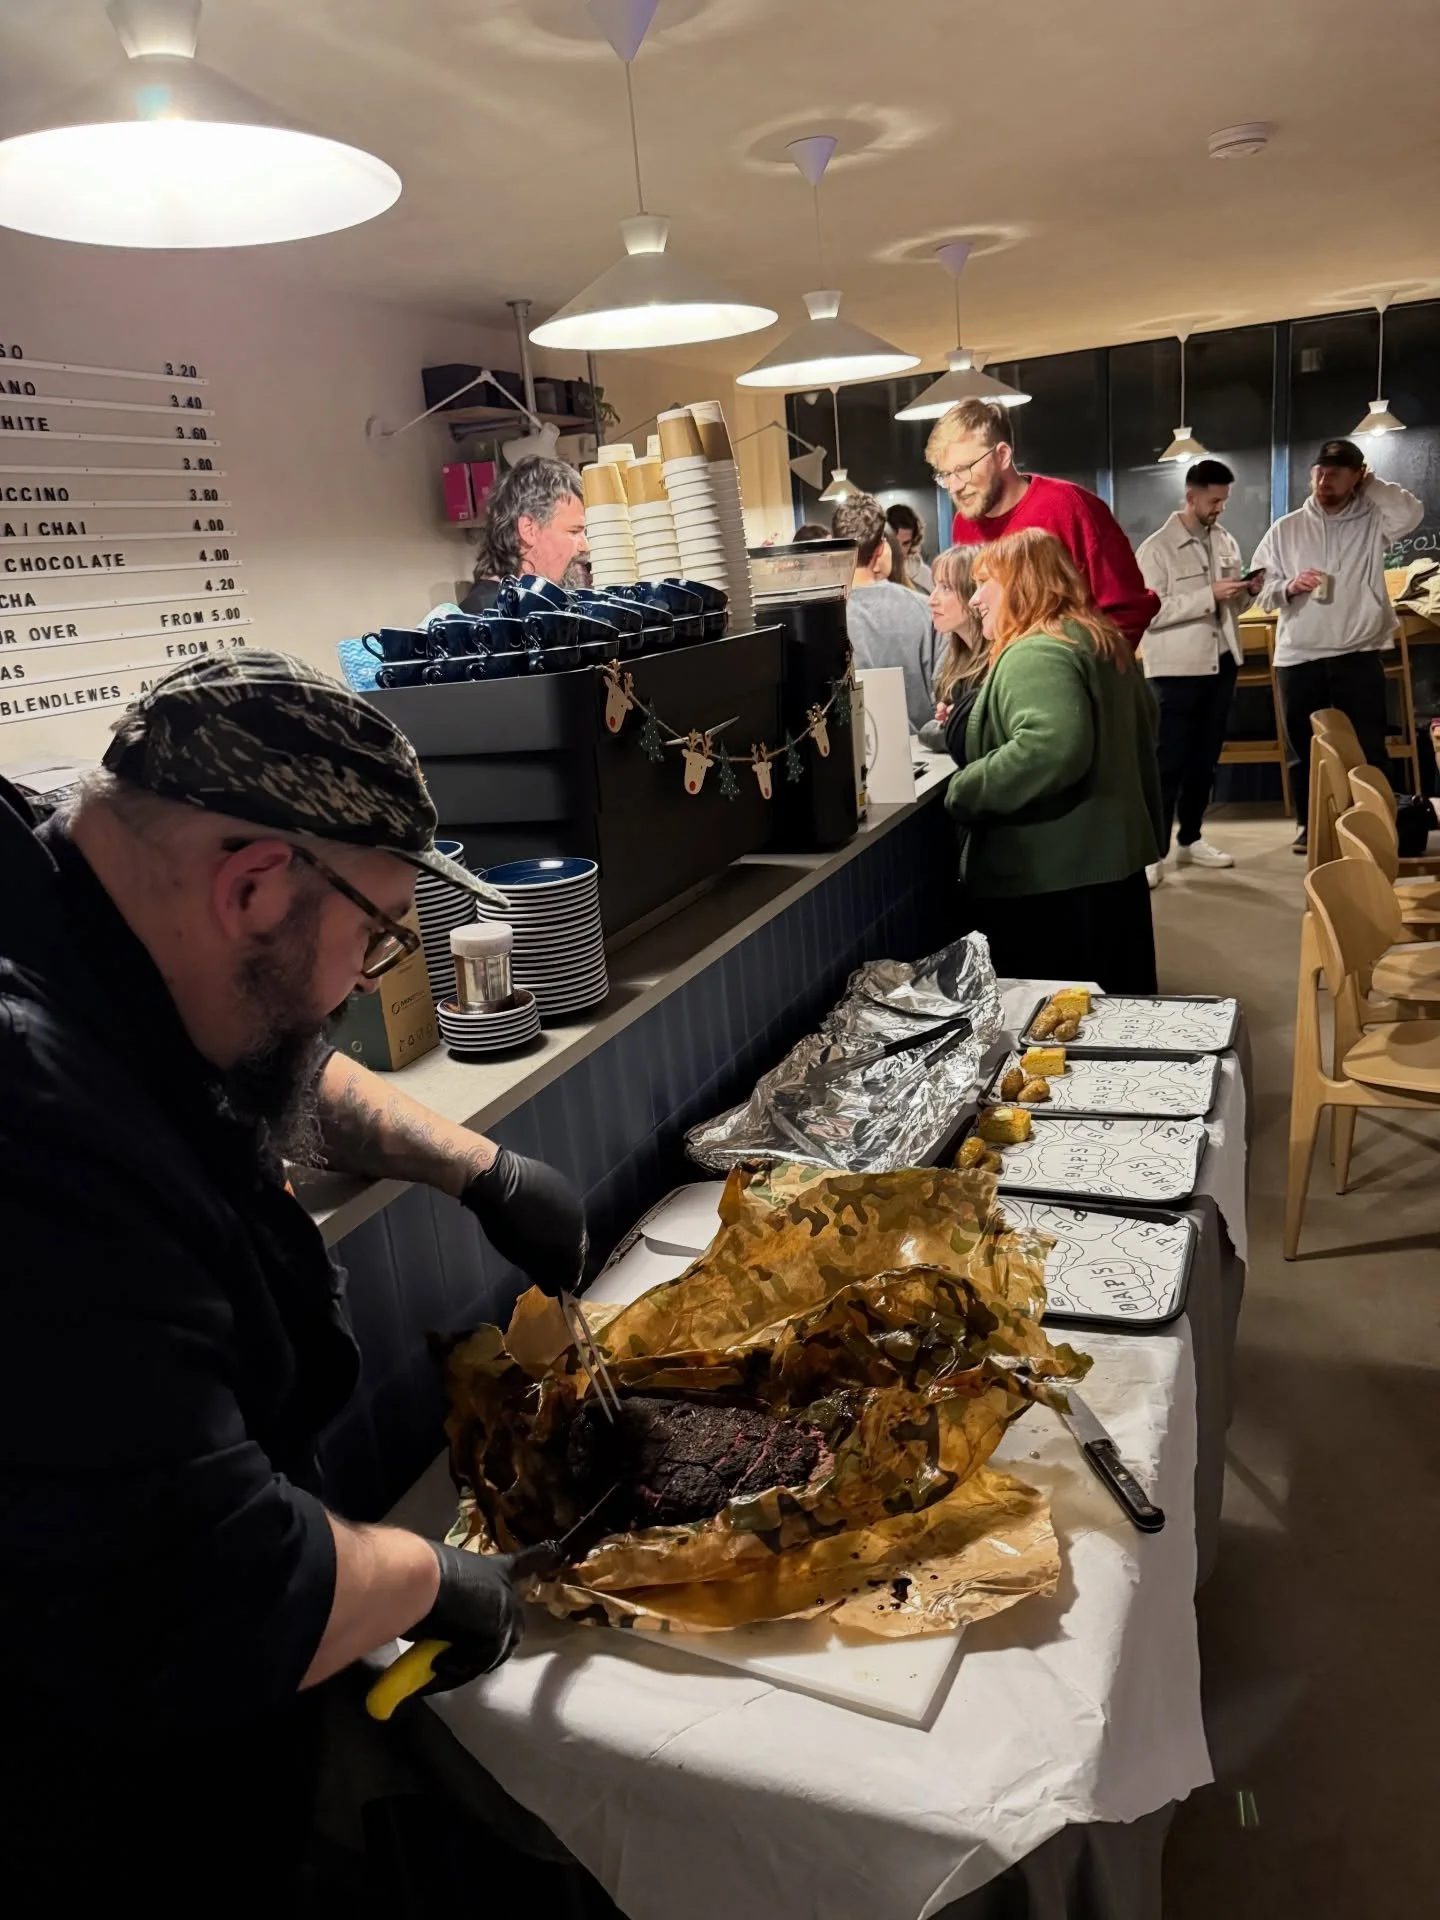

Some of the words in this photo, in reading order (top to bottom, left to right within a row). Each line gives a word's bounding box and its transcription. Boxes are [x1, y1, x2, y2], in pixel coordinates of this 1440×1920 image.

[165, 362, 197, 378] 3.20
[171, 394, 202, 409] 3.40
[176, 426, 207, 441] 3.60
[183, 457, 213, 471] 3.80
[0, 487, 69, 502] CCINO
[190, 489, 218, 501] 3.80
[38, 521, 87, 536] CHAI
[193, 519, 224, 532] 4.00
[4, 553, 126, 573] CHOCOLATE
[200, 549, 229, 562] 4.00
[205, 578, 235, 592] 4.20
[29, 623, 79, 641] OVER
[160, 611, 204, 627] FROM
[211, 607, 241, 622] 5.00
[166, 641, 209, 658] FROM
[217, 636, 246, 650] 320
[0, 685, 121, 716] BLENDLEWES
[1091, 1266, 1140, 1313] DAPS
